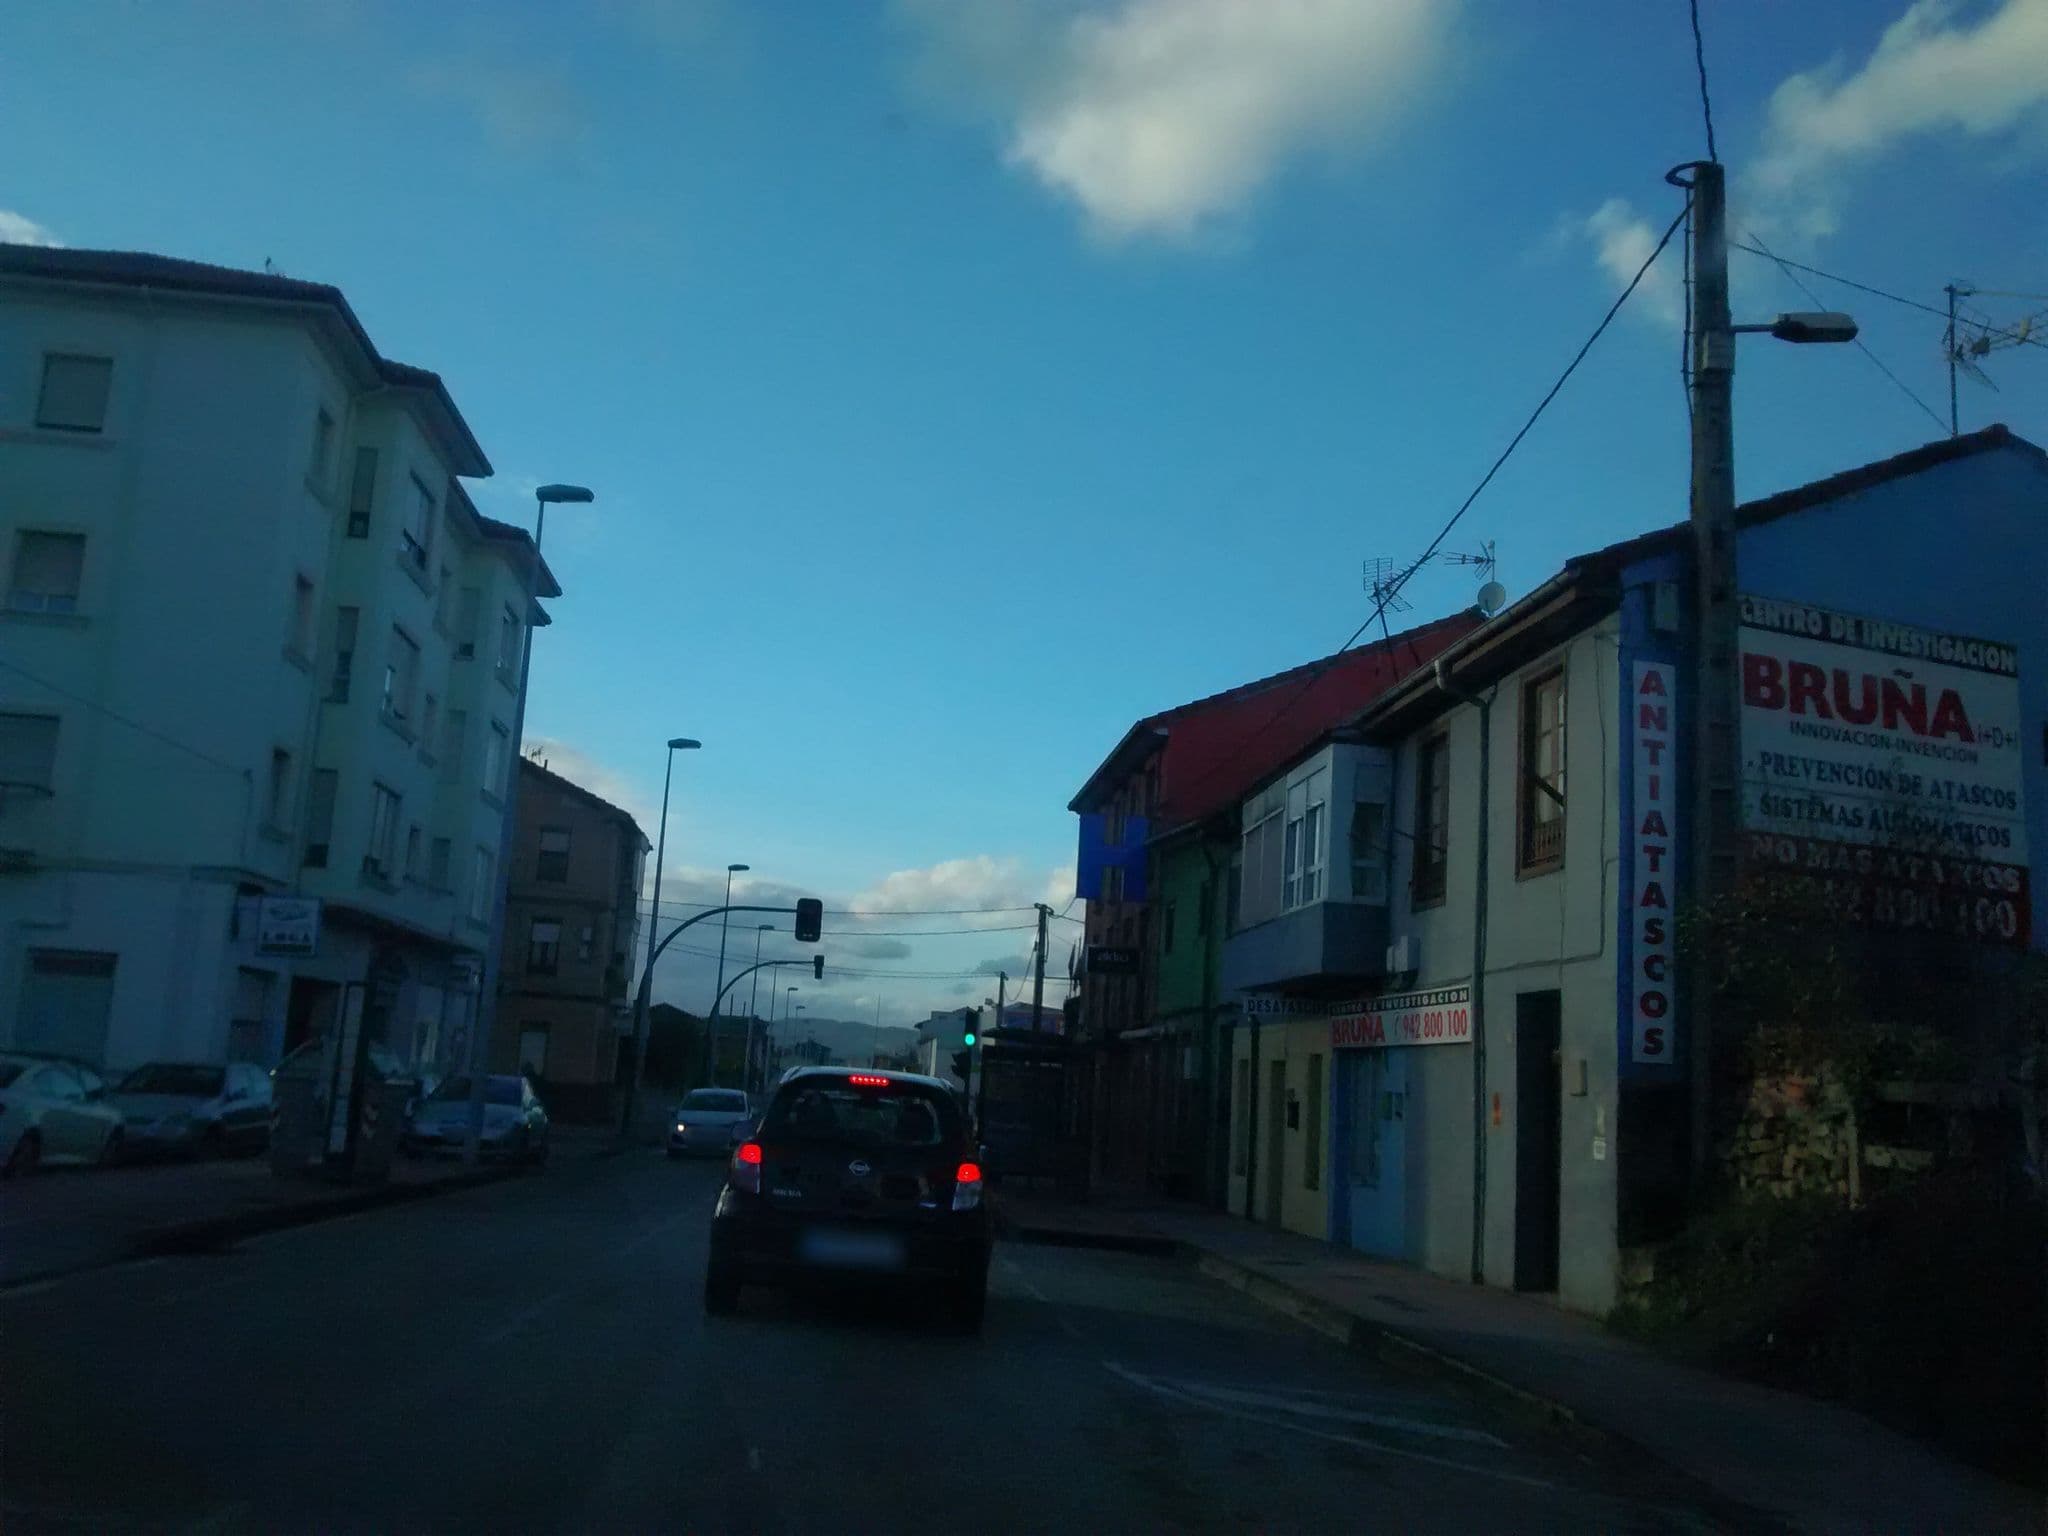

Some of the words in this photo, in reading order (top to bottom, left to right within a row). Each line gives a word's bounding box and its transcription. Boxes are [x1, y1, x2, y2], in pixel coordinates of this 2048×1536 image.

[1740, 602, 1823, 636] CENTRO
[1830, 618, 1857, 642] DE
[1743, 652, 1974, 742] BRUÑA
[1897, 773, 1922, 796] DE
[1930, 780, 2017, 809] ATASCOS
[1760, 793, 1864, 827] SISTEMAS
[1639, 670, 1667, 1055] ANTIATASCOS
[1381, 990, 1467, 1009] INVESTIGACION
[1424, 1011, 1443, 1038] 800
[1447, 1008, 1467, 1036] 100
